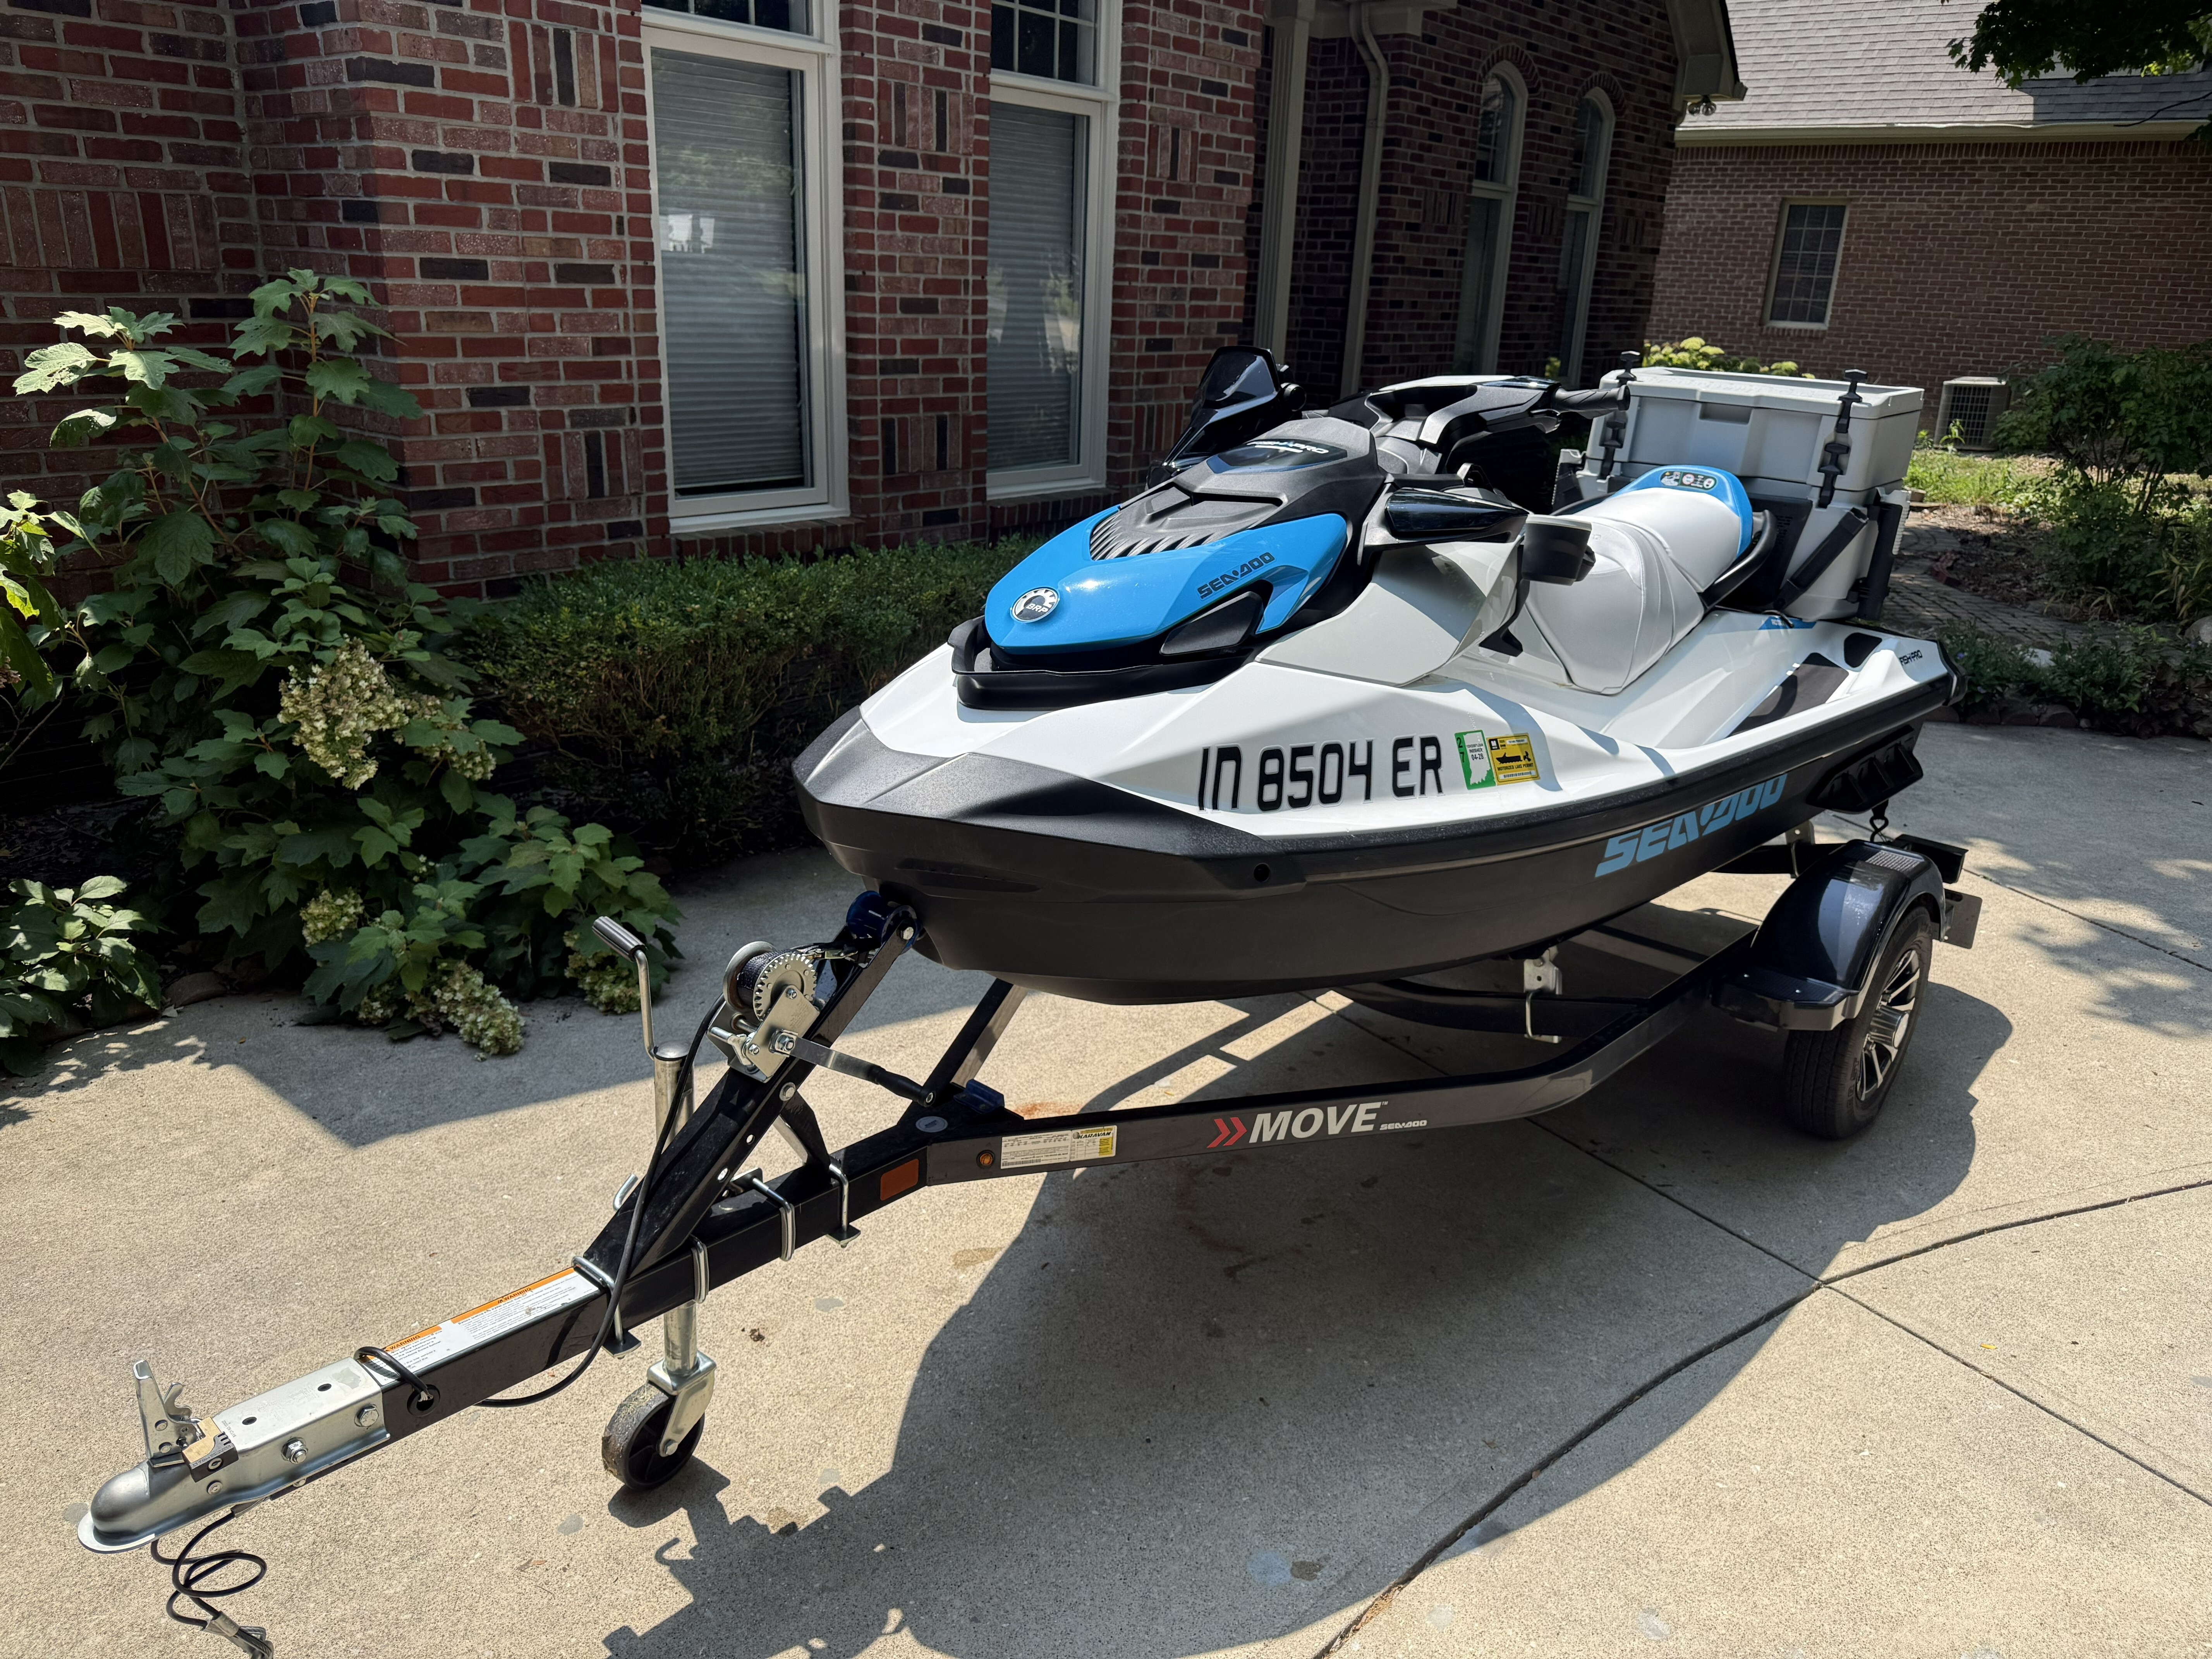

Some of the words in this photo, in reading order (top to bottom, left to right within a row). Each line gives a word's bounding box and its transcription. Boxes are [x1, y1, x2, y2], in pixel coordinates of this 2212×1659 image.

[1026, 603, 1048, 612] BRP
[1200, 746, 1242, 811] IN
[1259, 740, 1371, 811] 8504
[1394, 736, 1443, 797] ER
[1249, 1101, 1382, 1144] MOVE
[390, 1335, 421, 1350] WARNING
